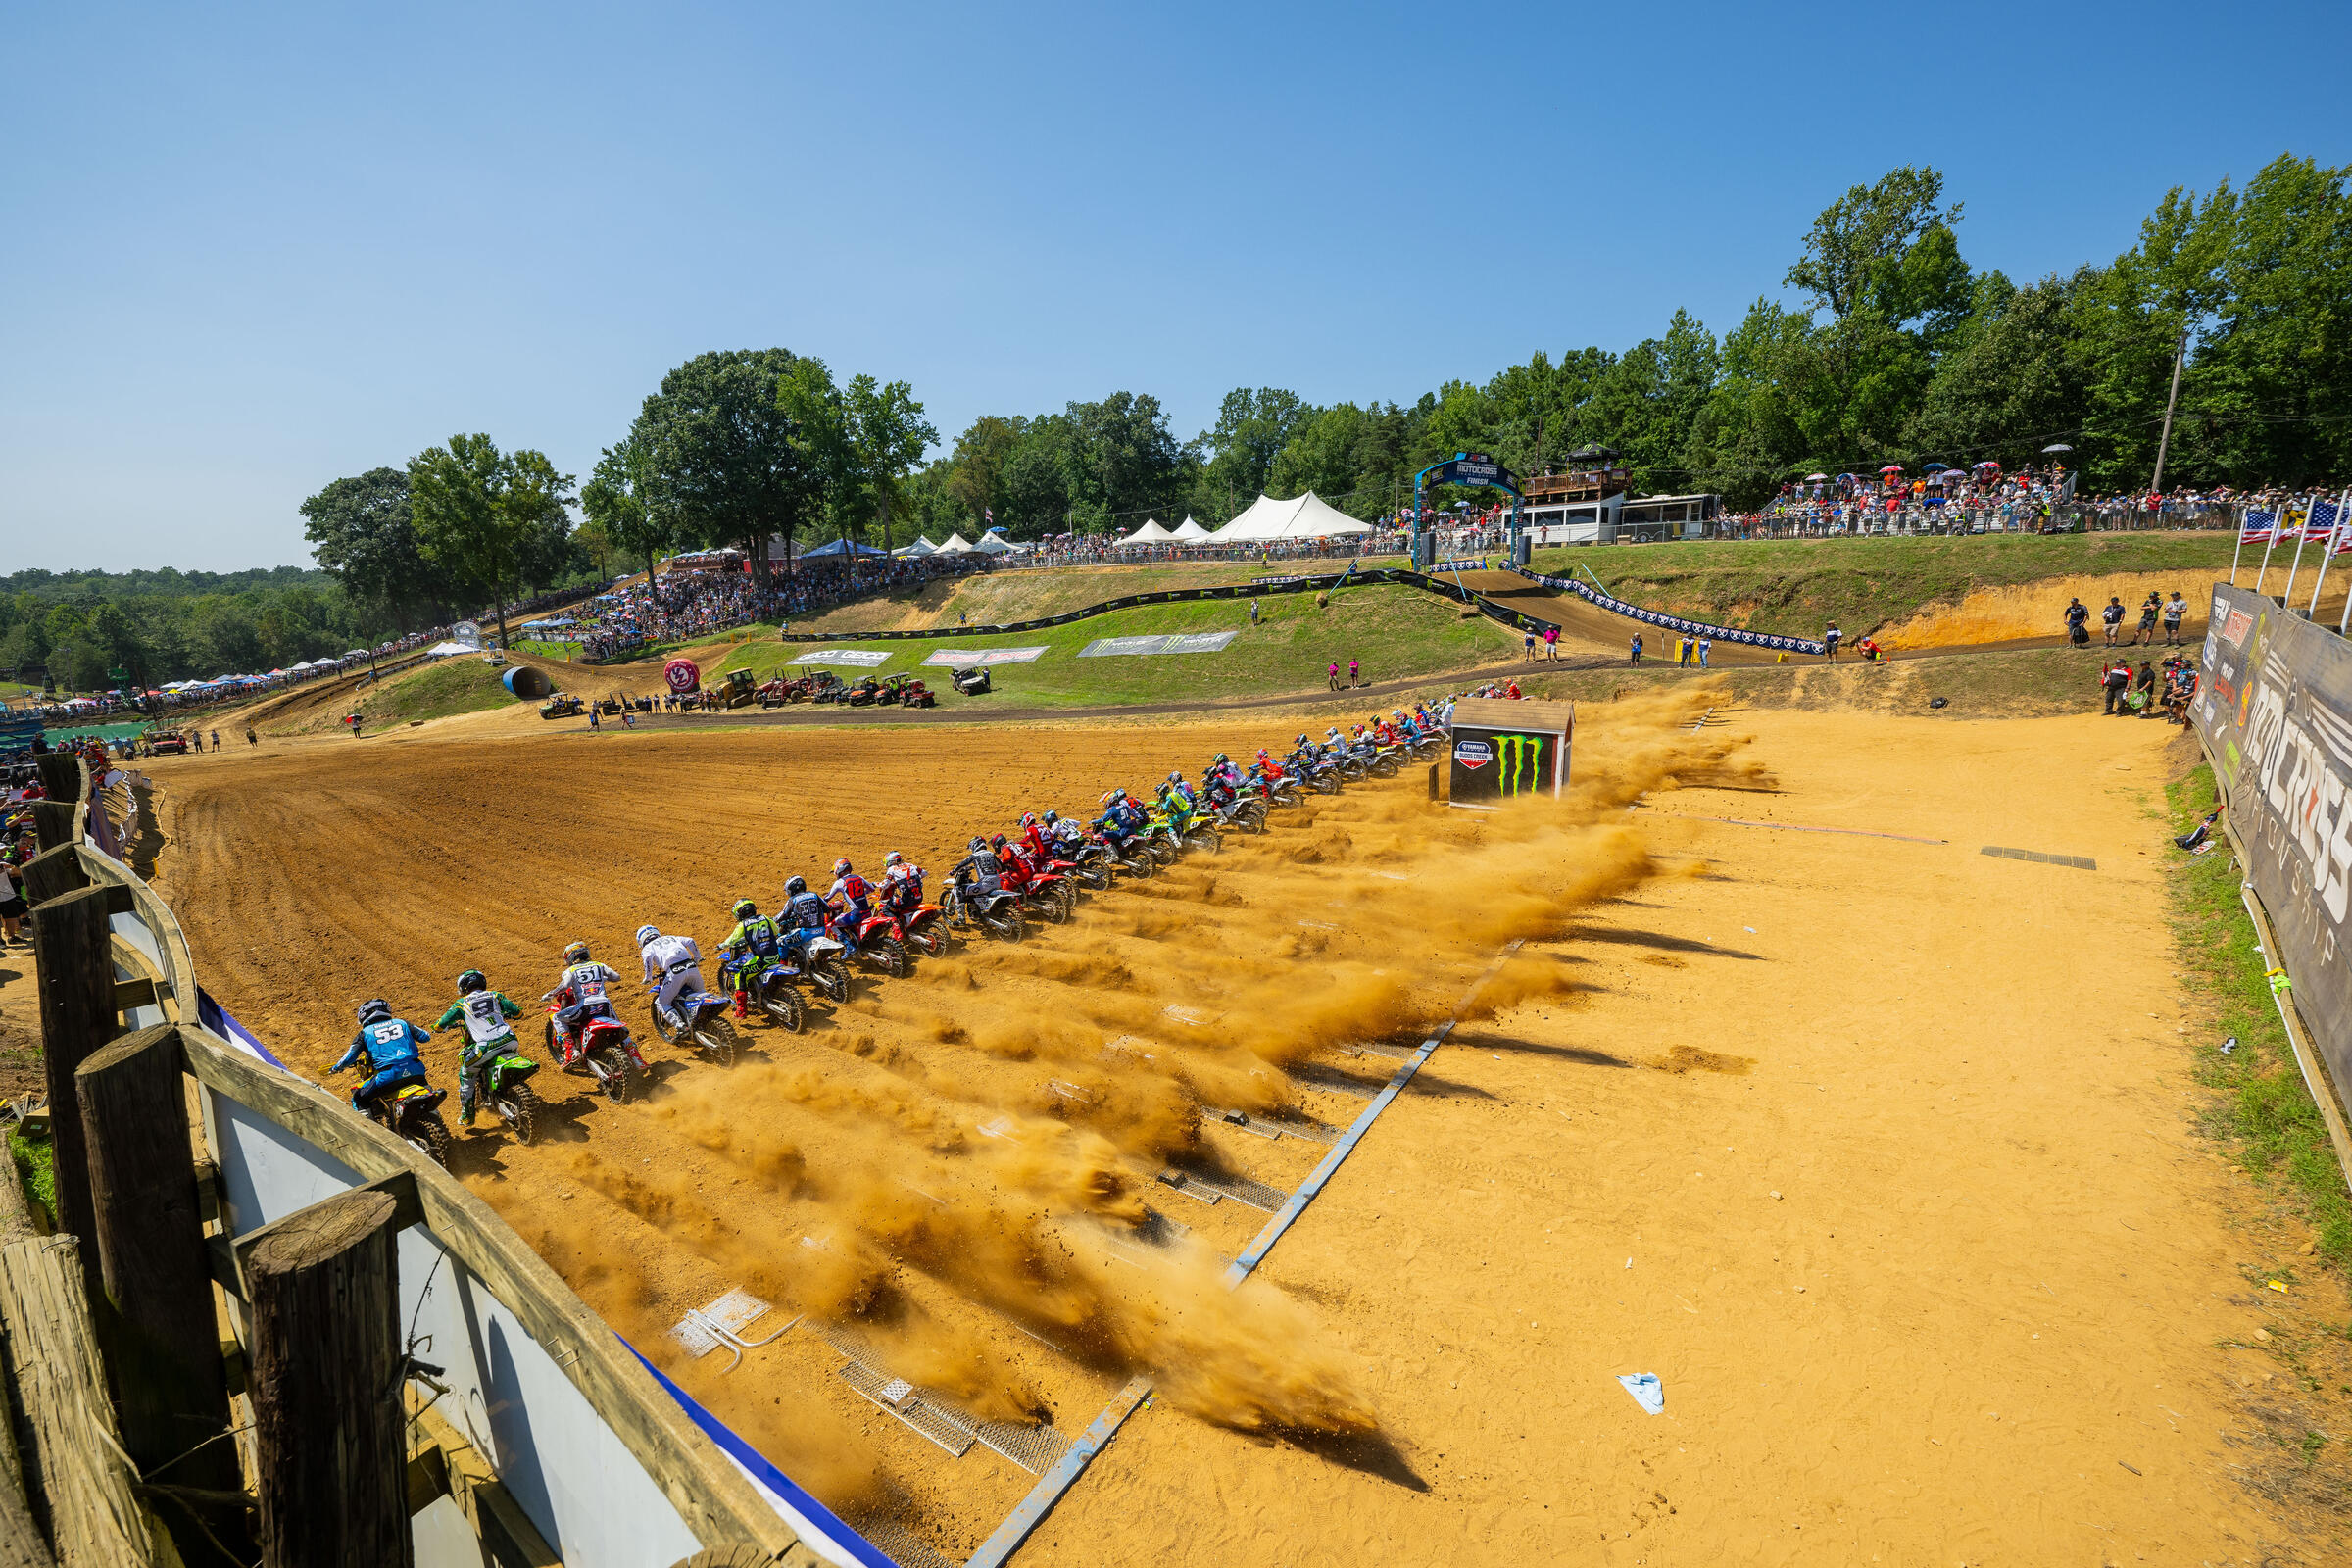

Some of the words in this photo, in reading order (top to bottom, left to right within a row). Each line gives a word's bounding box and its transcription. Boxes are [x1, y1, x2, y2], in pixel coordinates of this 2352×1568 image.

[1457, 465, 1497, 475] MOTOCROSS
[1466, 476, 1489, 486] FINISH
[901, 868, 911, 880] 7
[847, 879, 864, 899] 18
[799, 899, 819, 917] 36
[576, 965, 603, 984] 51
[742, 963, 761, 974] FXR
[471, 996, 495, 1019] 9
[374, 1024, 405, 1045] 53
